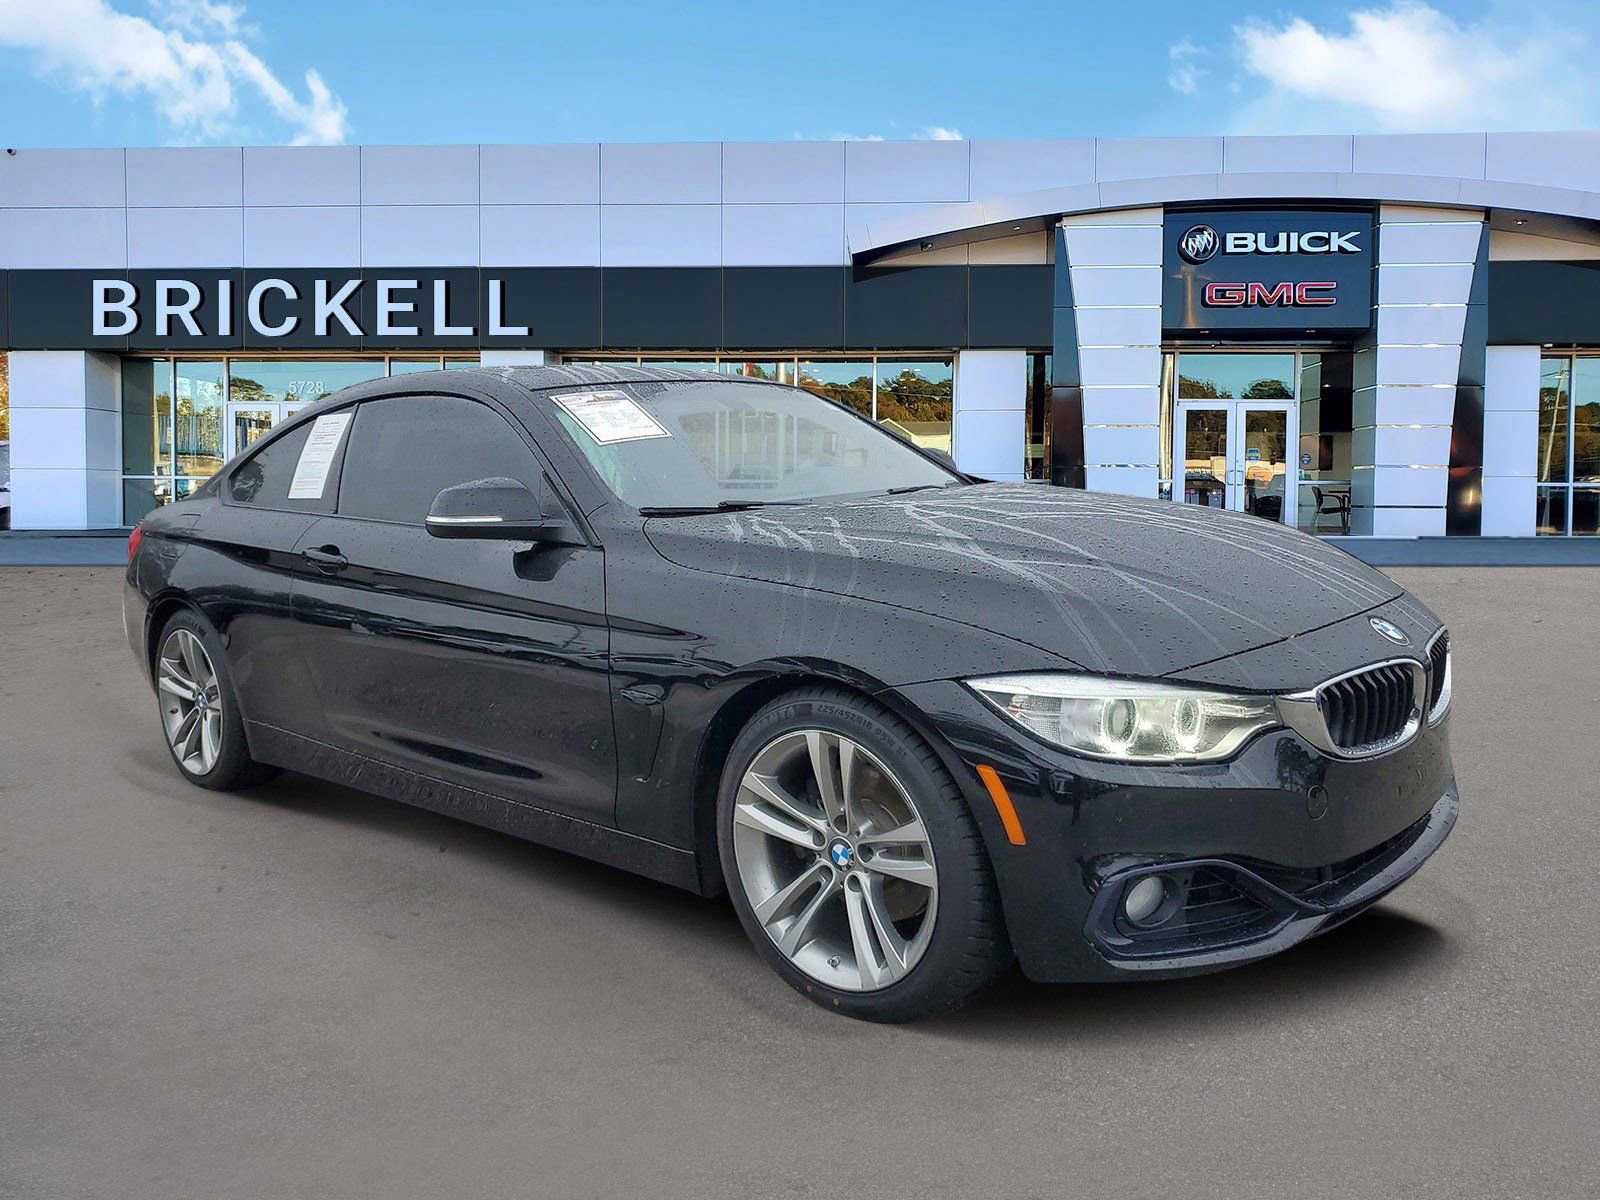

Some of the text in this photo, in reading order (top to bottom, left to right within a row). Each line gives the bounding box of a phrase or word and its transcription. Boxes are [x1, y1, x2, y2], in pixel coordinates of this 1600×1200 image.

[1225, 231, 1361, 253] BUICK
[1205, 282, 1337, 305] GMC
[92, 278, 529, 337] BRICKELL
[288, 380, 325, 395] 5728
